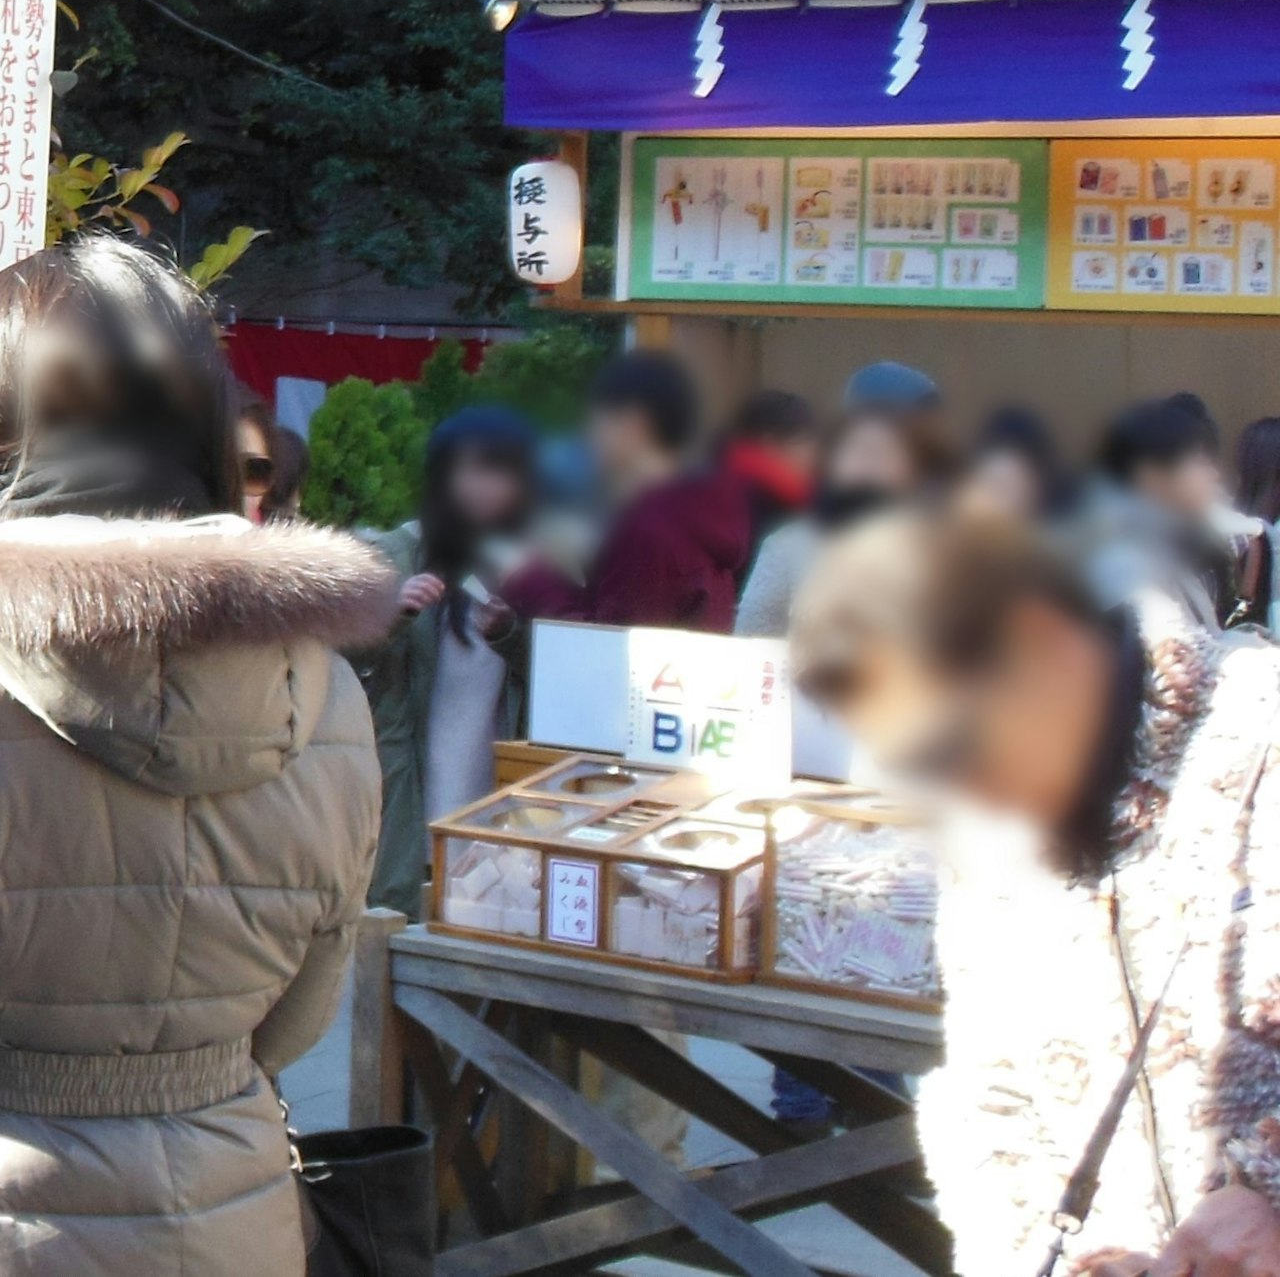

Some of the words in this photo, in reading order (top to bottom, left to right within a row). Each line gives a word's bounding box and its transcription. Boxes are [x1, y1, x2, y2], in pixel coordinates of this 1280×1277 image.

[514, 176, 549, 276] 授与所
[653, 711, 682, 754] B
[573, 874, 589, 935] 血液型
